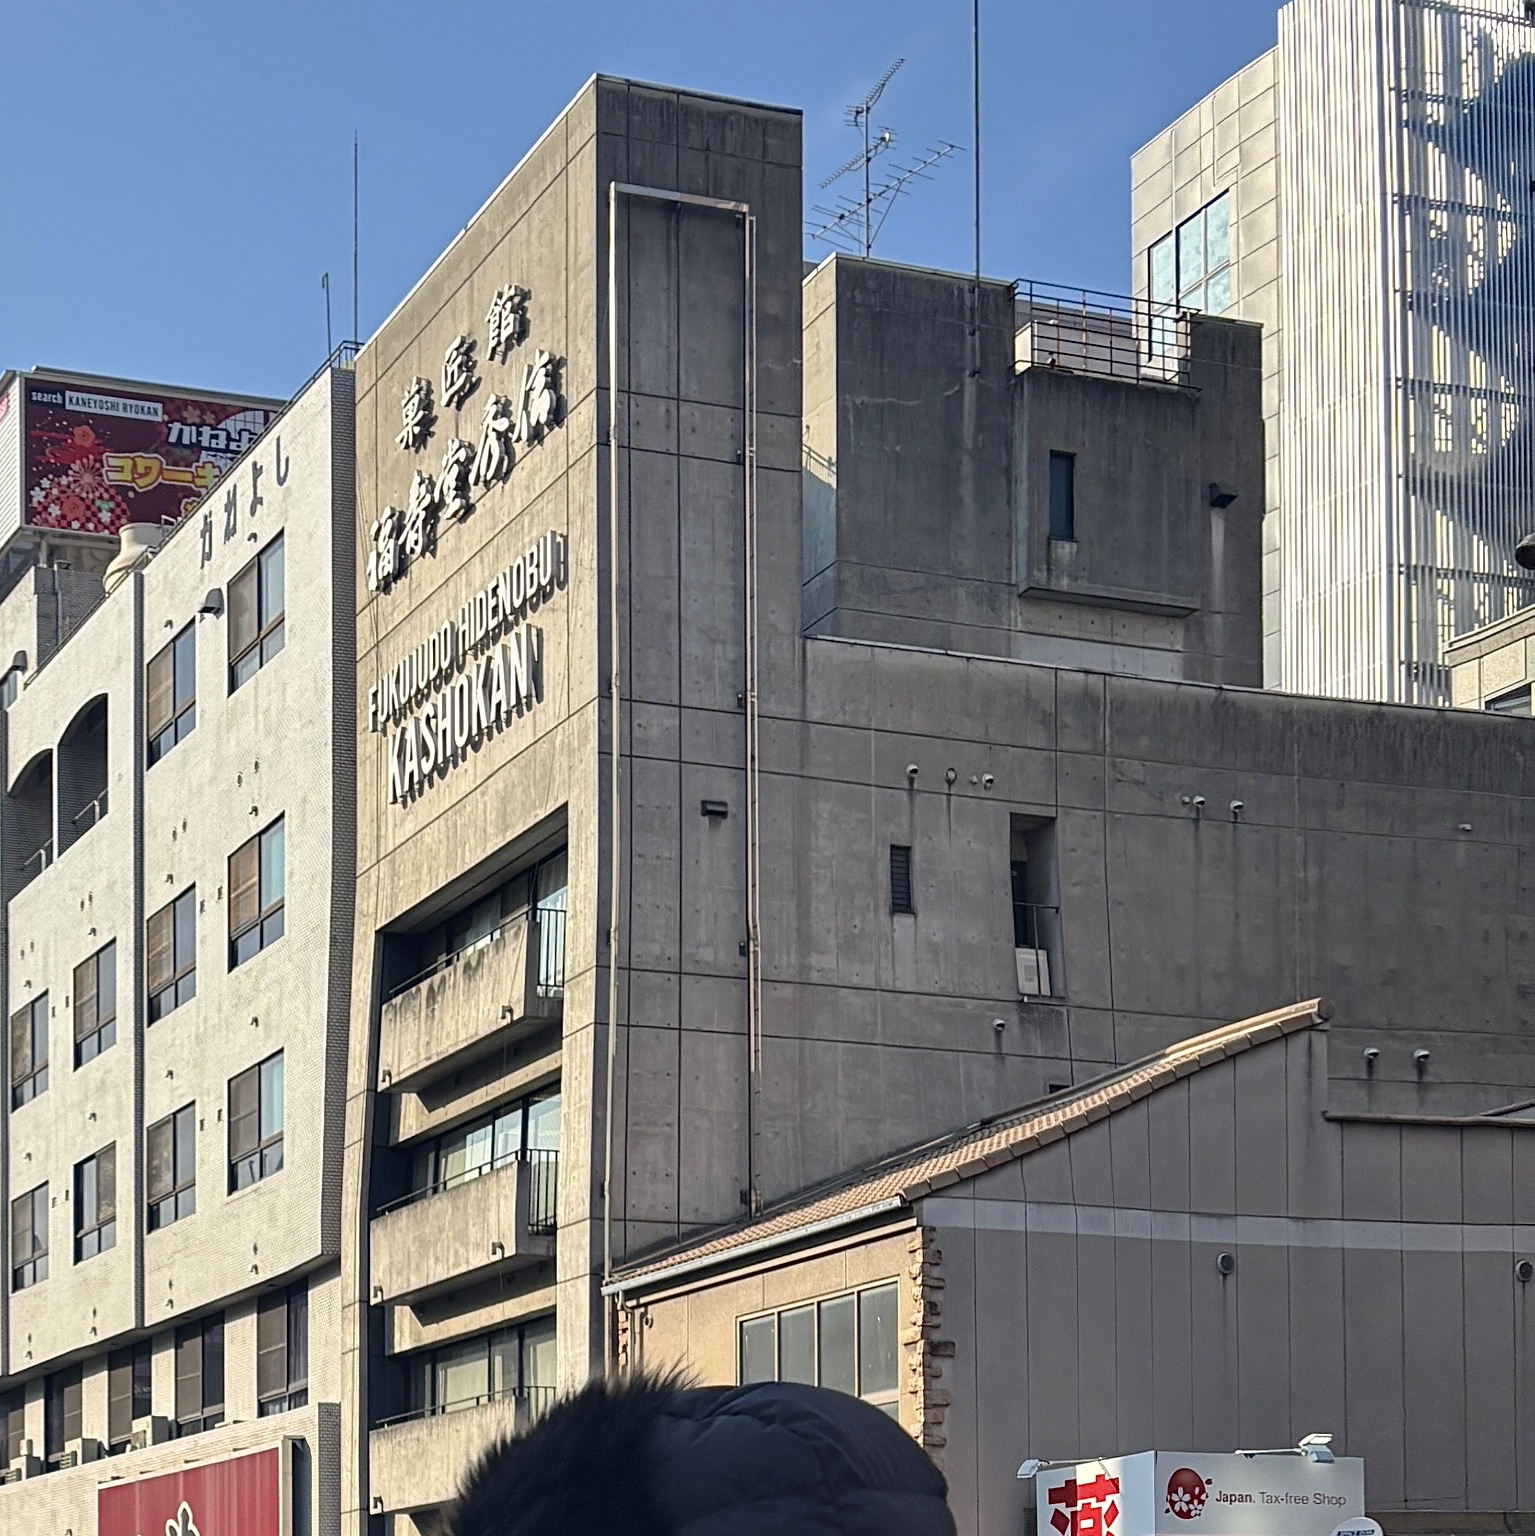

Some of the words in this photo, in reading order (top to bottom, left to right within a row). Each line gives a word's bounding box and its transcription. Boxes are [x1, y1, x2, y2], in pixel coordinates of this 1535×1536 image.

[31, 390, 63, 404] search
[68, 397, 120, 412] KANEYOSHI
[122, 405, 159, 417] RYOKAN
[201, 435, 289, 570] かねよし
[368, 619, 452, 733] FUKUJUDO
[458, 530, 556, 654] HIDENOBU
[388, 623, 539, 804] KASHOKAN
[1215, 1490, 1256, 1505] Japan.
[1258, 1491, 1309, 1505] Tax-free
[1312, 1492, 1347, 1508] Shop
